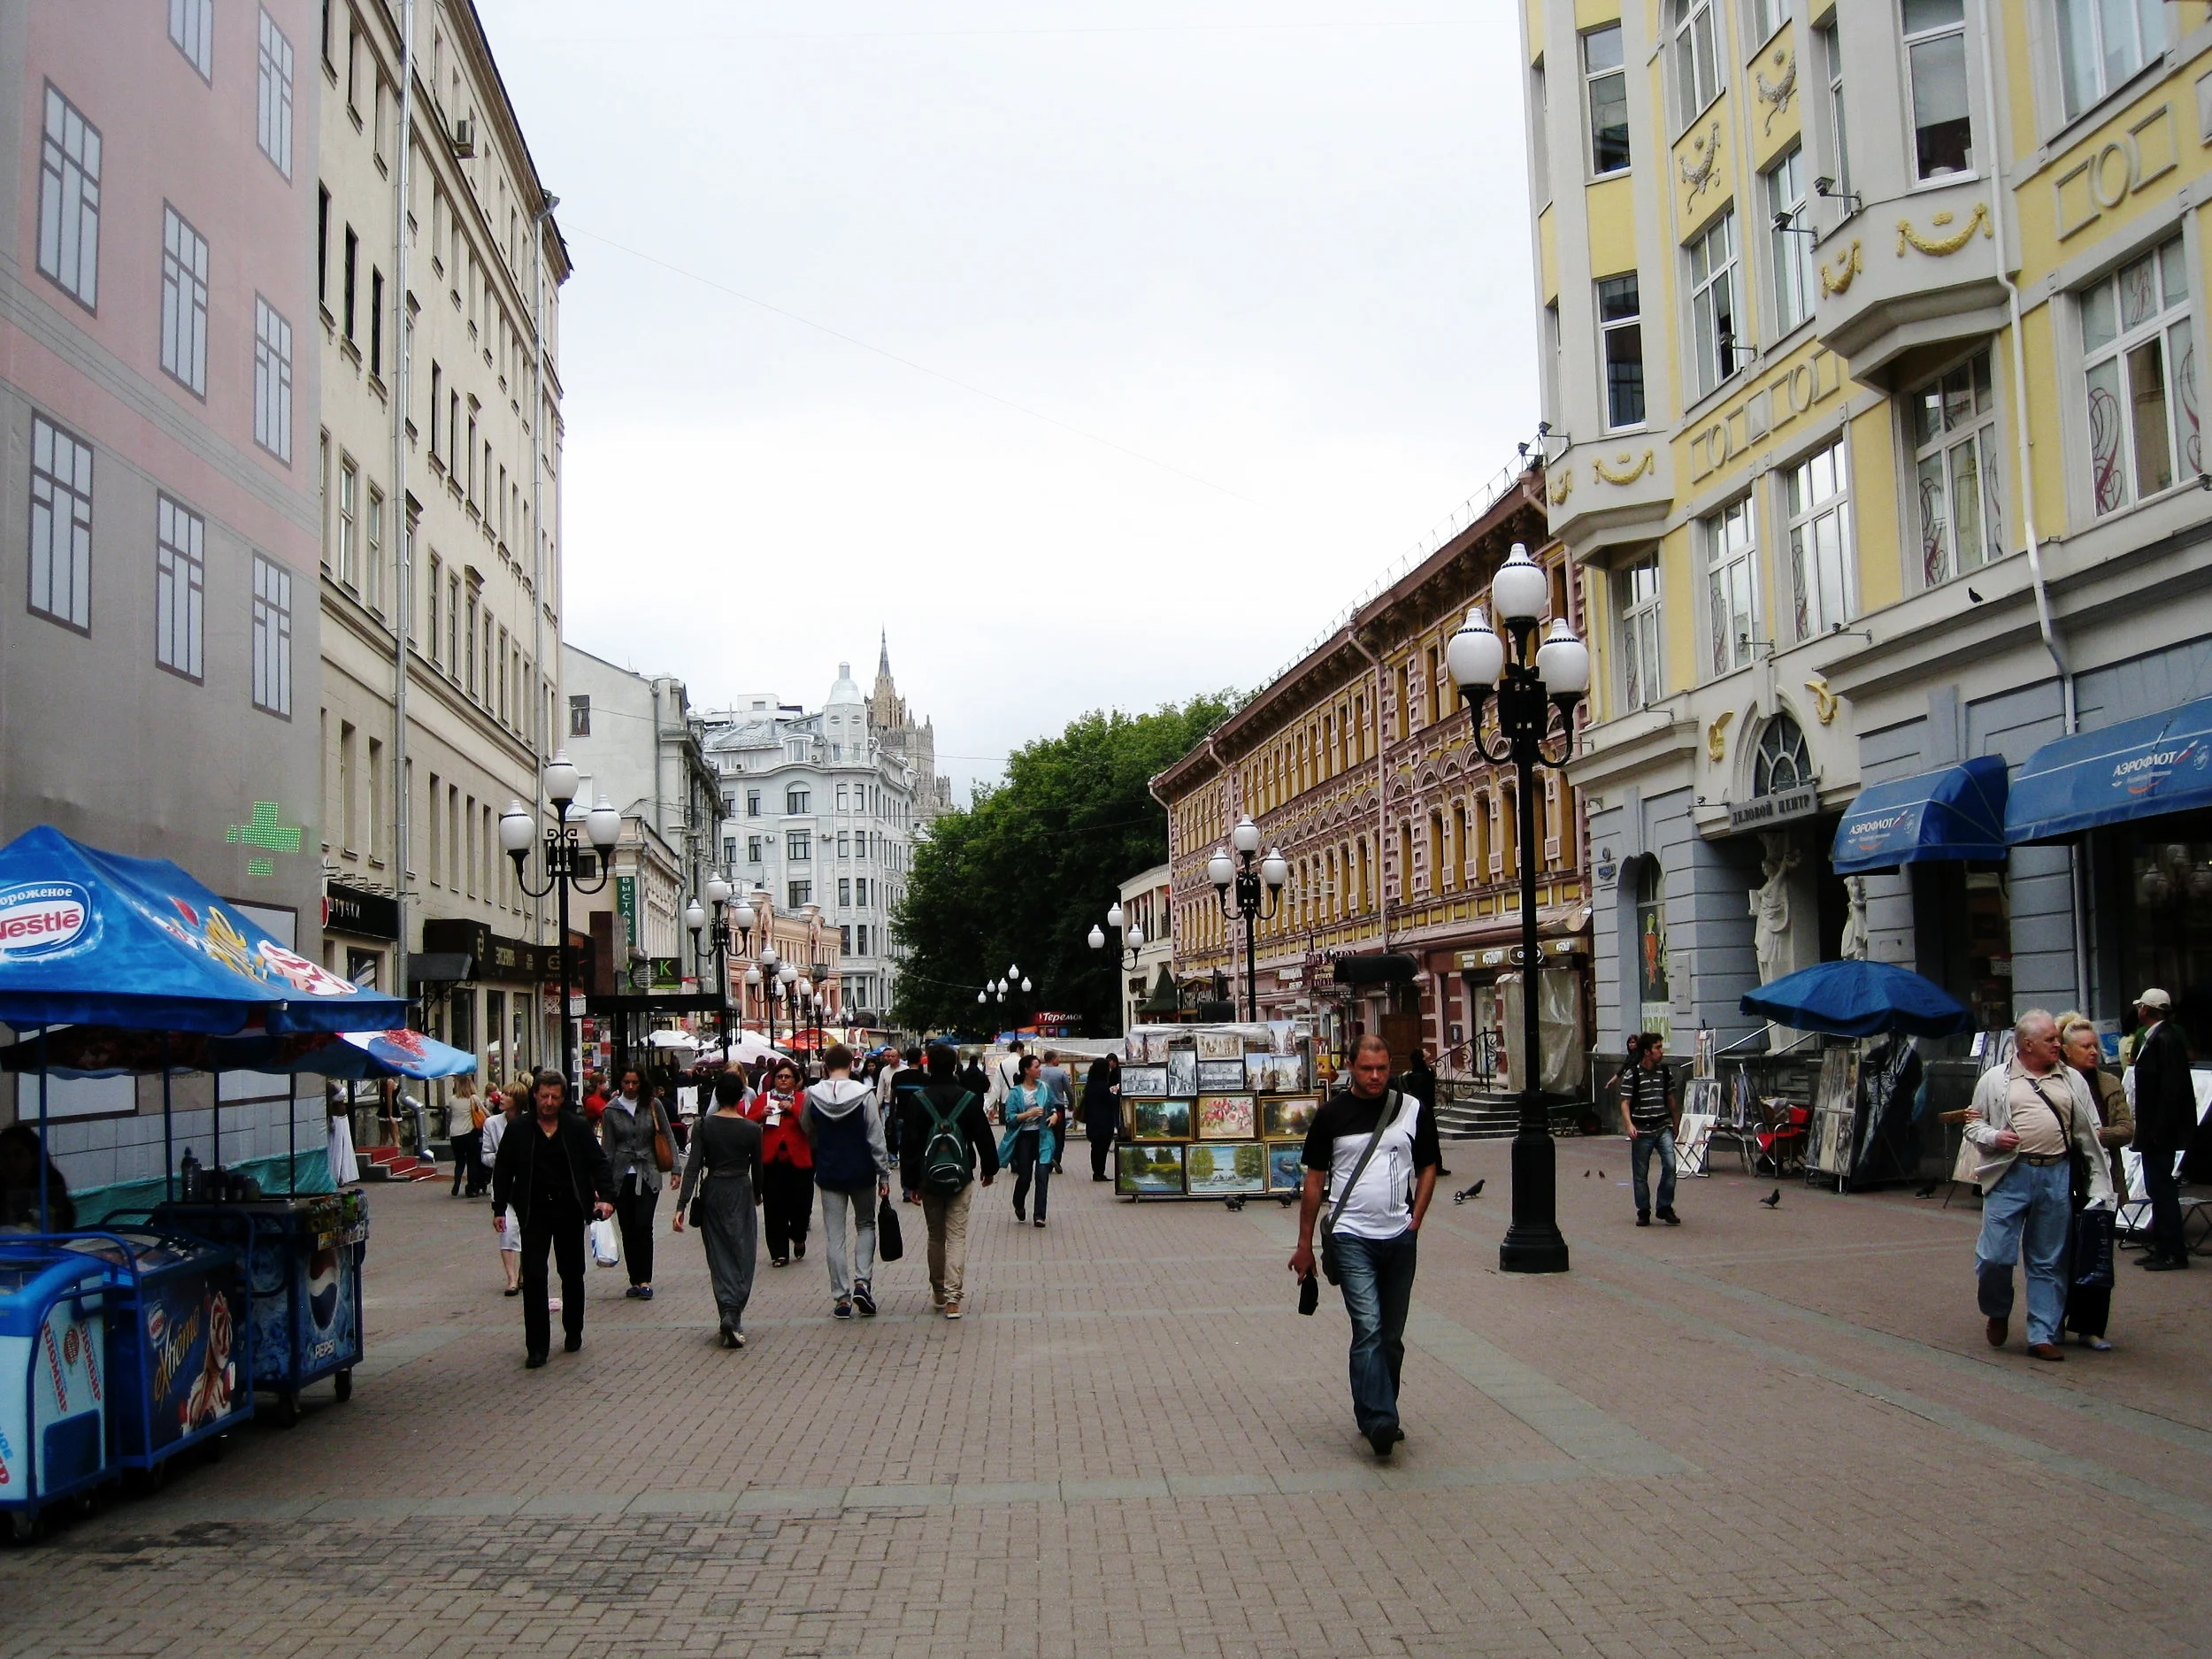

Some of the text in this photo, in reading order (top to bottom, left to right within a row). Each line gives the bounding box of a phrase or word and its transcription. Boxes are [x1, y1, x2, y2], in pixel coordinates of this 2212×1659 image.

[2112, 750, 2177, 777] АЭРОФЛОТ
[1731, 794, 1810, 826] ДЕЛОВОЙ ЦЕНТР
[1849, 818, 1894, 834] АЭРОФЛОТ
[1042, 1011, 1083, 1024] Теремок
[315, 1339, 335, 1360] PEPSI
